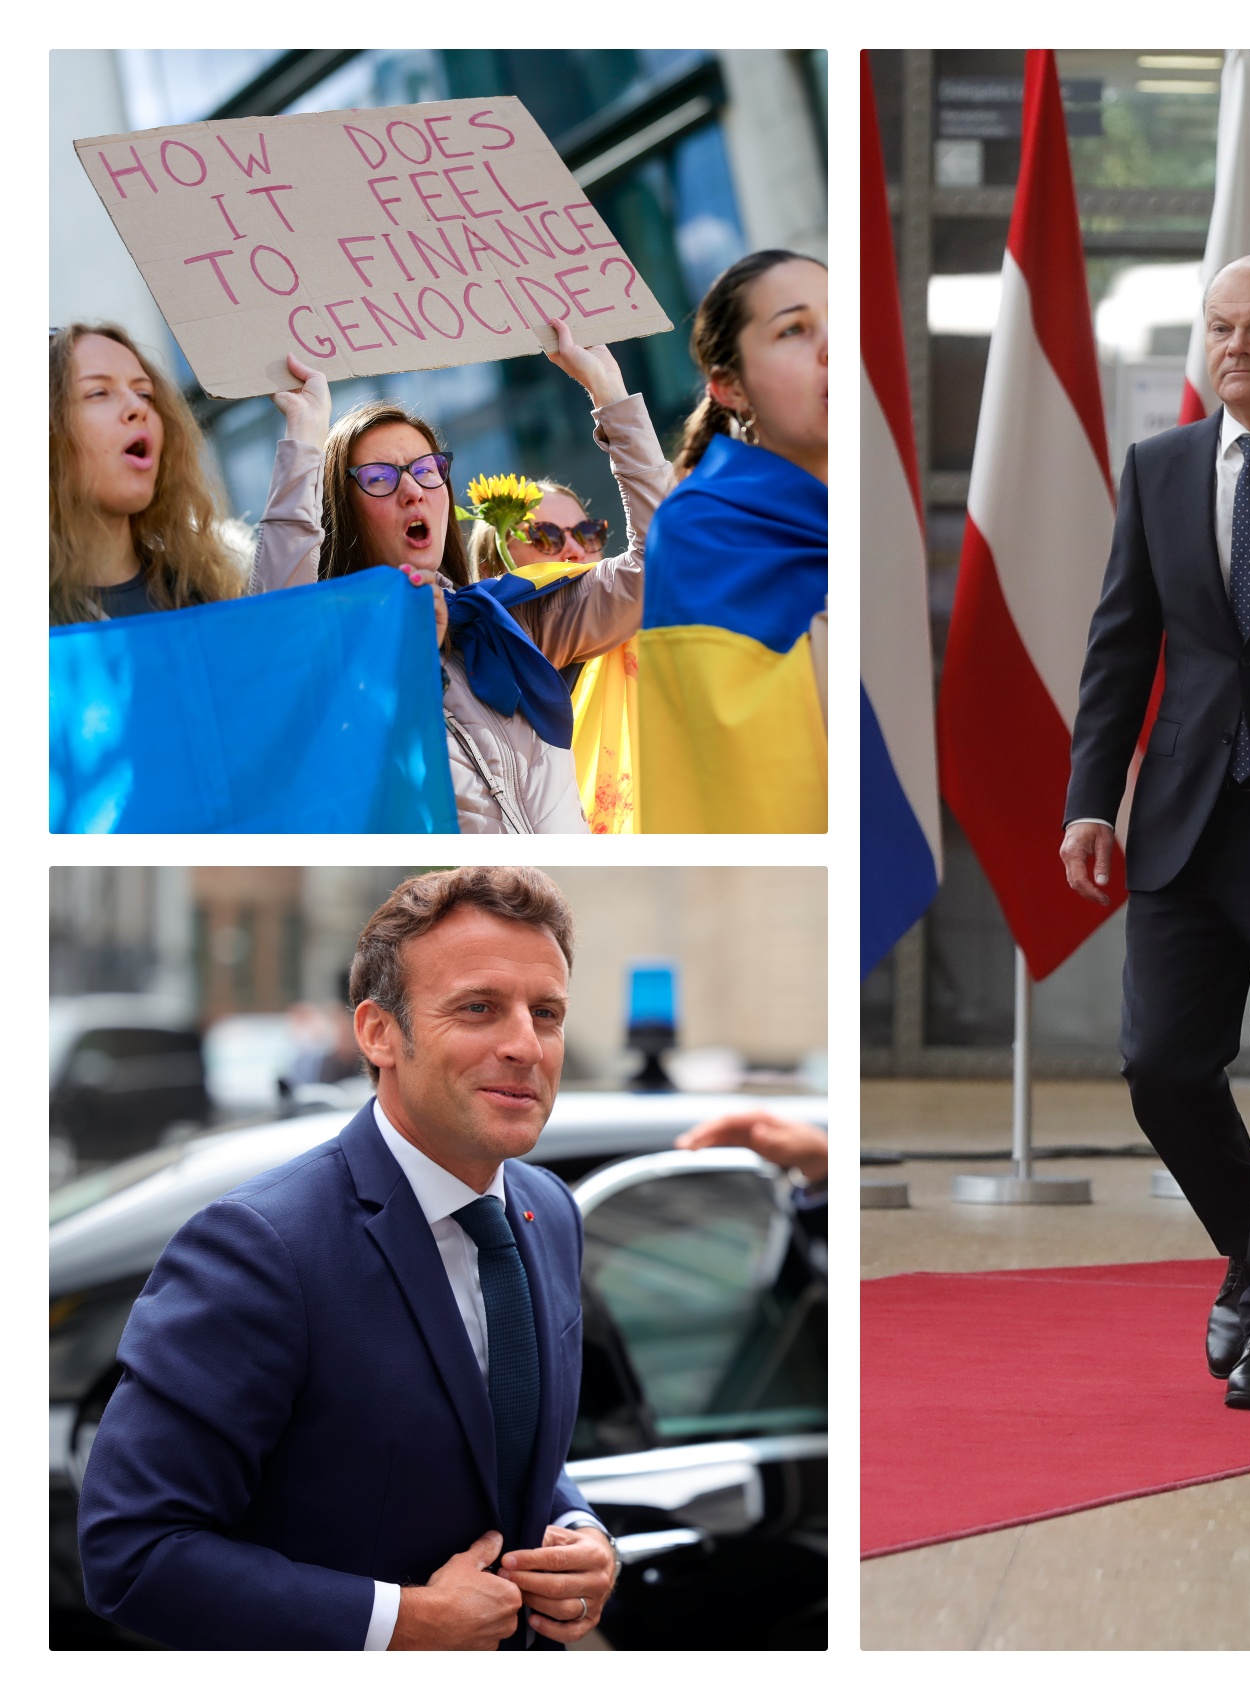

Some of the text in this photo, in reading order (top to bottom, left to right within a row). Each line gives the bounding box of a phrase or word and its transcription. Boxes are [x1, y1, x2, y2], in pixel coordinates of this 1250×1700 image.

[98, 110, 515, 199] HOW DOES
[210, 160, 549, 241] IT FEEL
[183, 202, 621, 305] TO FINANCE
[287, 257, 637, 359] GENOCIDE?
